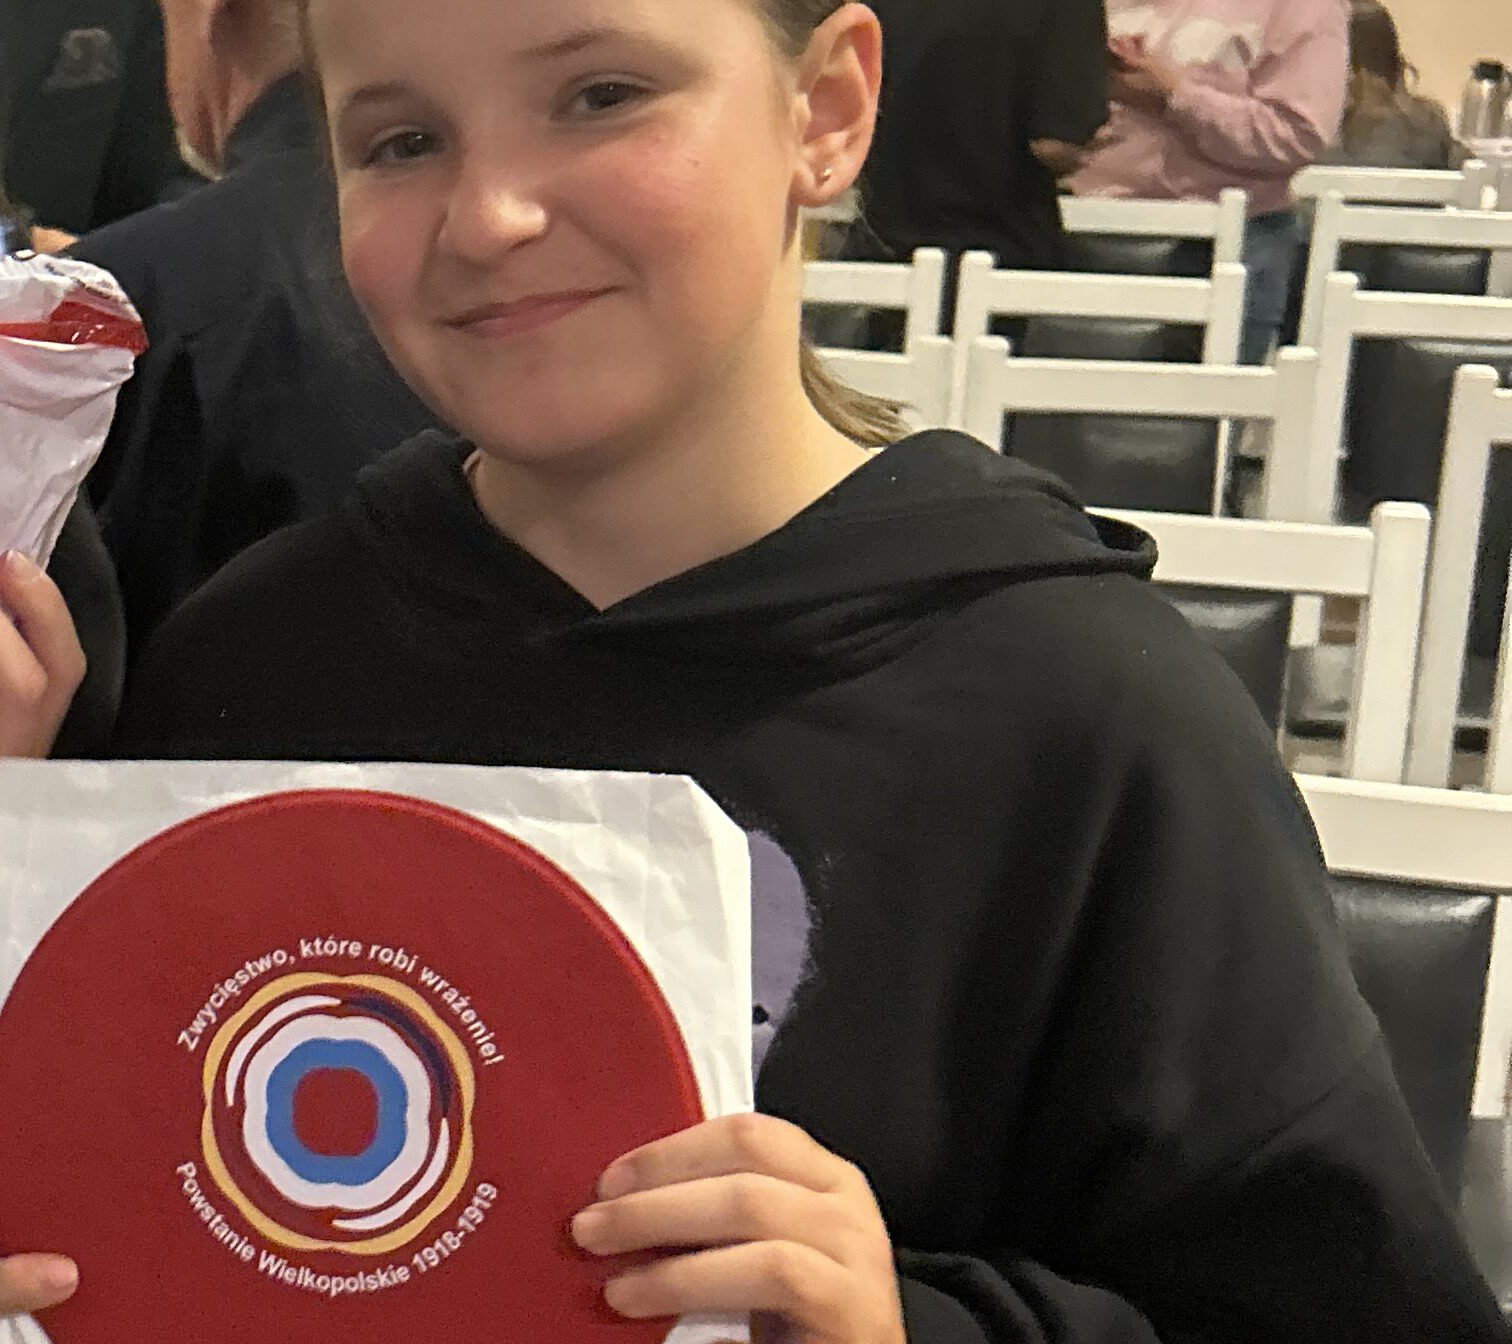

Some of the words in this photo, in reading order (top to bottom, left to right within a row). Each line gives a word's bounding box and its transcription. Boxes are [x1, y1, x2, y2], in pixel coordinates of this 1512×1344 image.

[176, 947, 295, 1052] Zwycięstwo,
[300, 935, 363, 959] które
[370, 943, 419, 975] robi
[420, 965, 505, 1067] wrażenie!
[176, 1161, 257, 1263] Powstanie
[257, 1249, 411, 1298] Wielkopolskie
[412, 1181, 498, 1275] 1918-1919
